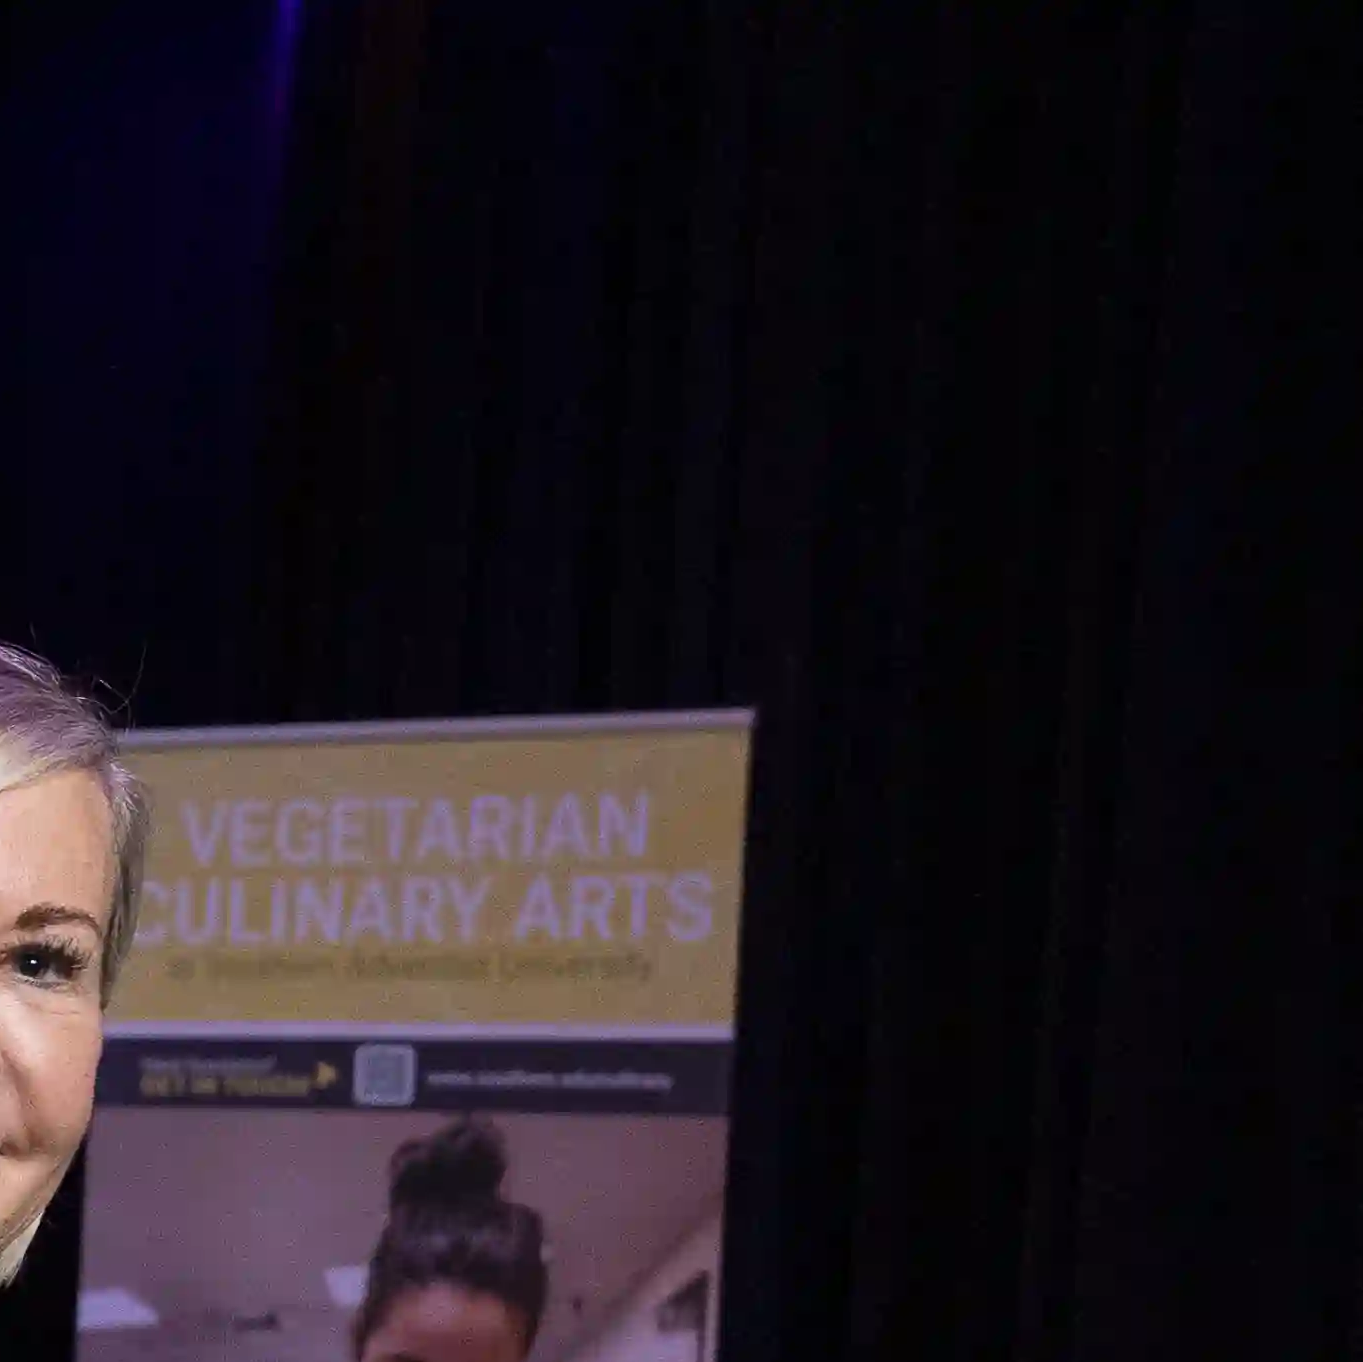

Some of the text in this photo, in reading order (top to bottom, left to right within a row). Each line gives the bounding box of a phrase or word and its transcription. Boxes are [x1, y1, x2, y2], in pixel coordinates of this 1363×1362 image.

[180, 793, 650, 868] VEGETARIAN
[133, 868, 714, 950] CULINARY ARTS
